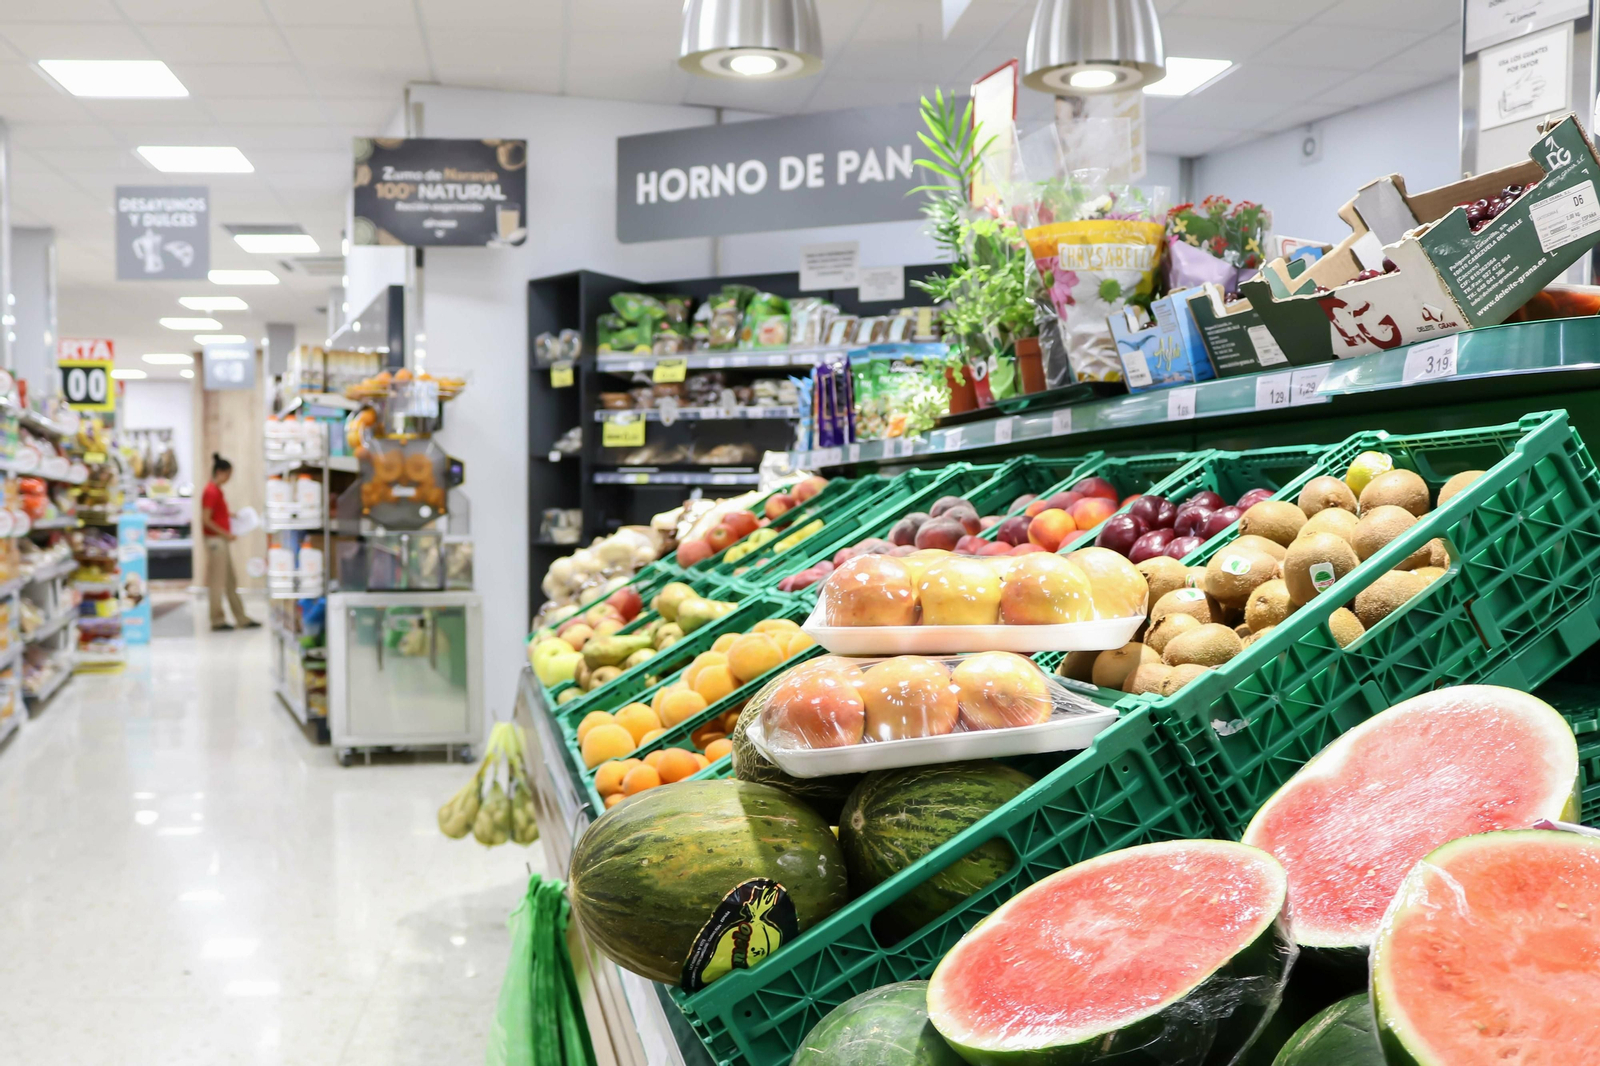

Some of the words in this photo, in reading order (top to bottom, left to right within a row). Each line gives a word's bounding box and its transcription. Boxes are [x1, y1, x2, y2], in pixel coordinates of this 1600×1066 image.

[1546, 147, 1572, 170] DG
[636, 159, 768, 205] HORNO
[779, 153, 825, 191] DE
[836, 144, 912, 185] PAN
[418, 183, 507, 201] NATURAL
[1572, 194, 1584, 207] D6
[118, 197, 206, 213] DESAYUNOS
[128, 213, 139, 227] Y
[142, 212, 197, 228] DULCES
[1476, 257, 1547, 317] www.deleite-grana.es
[58, 368, 106, 401] 00
